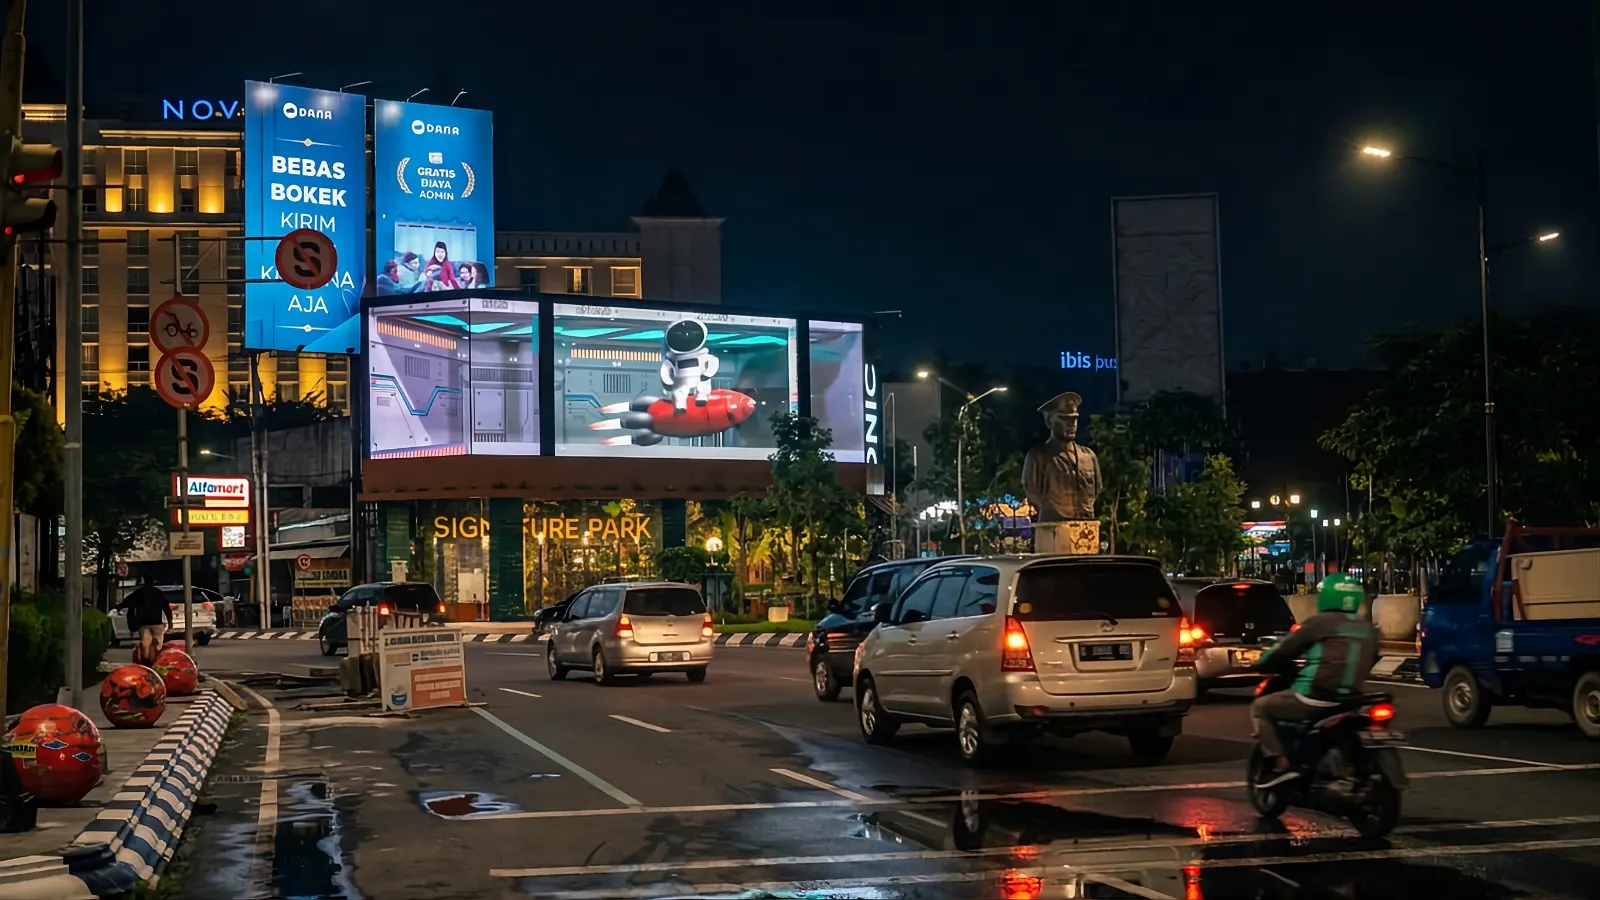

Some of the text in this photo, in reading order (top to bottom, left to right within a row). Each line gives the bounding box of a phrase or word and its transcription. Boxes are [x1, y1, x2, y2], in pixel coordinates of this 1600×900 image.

[299, 107, 332, 120] DANA
[426, 123, 460, 136] DANA
[272, 155, 346, 180] BEBAS
[417, 166, 456, 179] GRATIS
[270, 182, 347, 208] BOKEK
[281, 211, 336, 233] KIRIM
[287, 294, 329, 314] AJA
[1060, 351, 1092, 369] ibis
[189, 481, 244, 494] Alfamart
[588, 516, 652, 540] PARK
